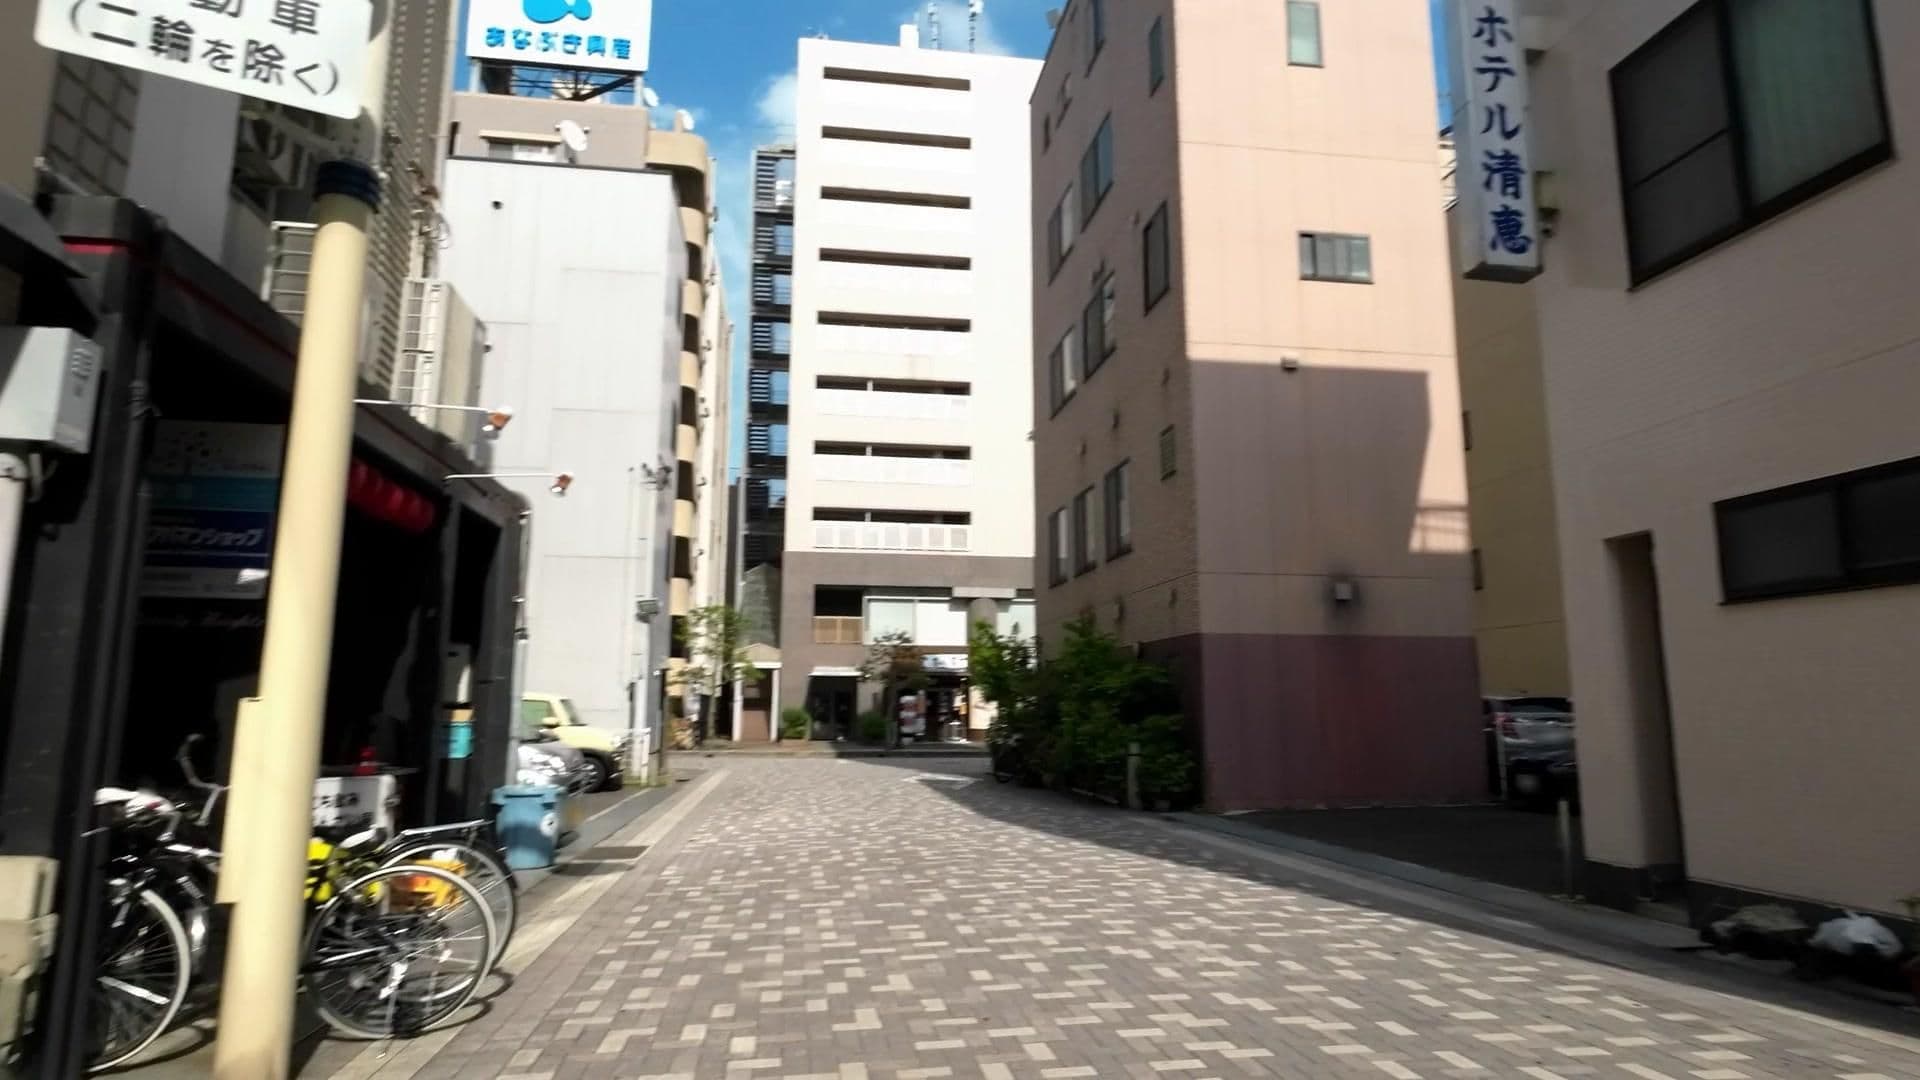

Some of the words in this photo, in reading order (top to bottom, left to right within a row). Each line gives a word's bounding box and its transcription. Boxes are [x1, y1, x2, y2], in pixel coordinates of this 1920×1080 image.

[70, 0, 339, 97] (二輪を除く)
[1472, 6, 1534, 255] ホテル清恵
